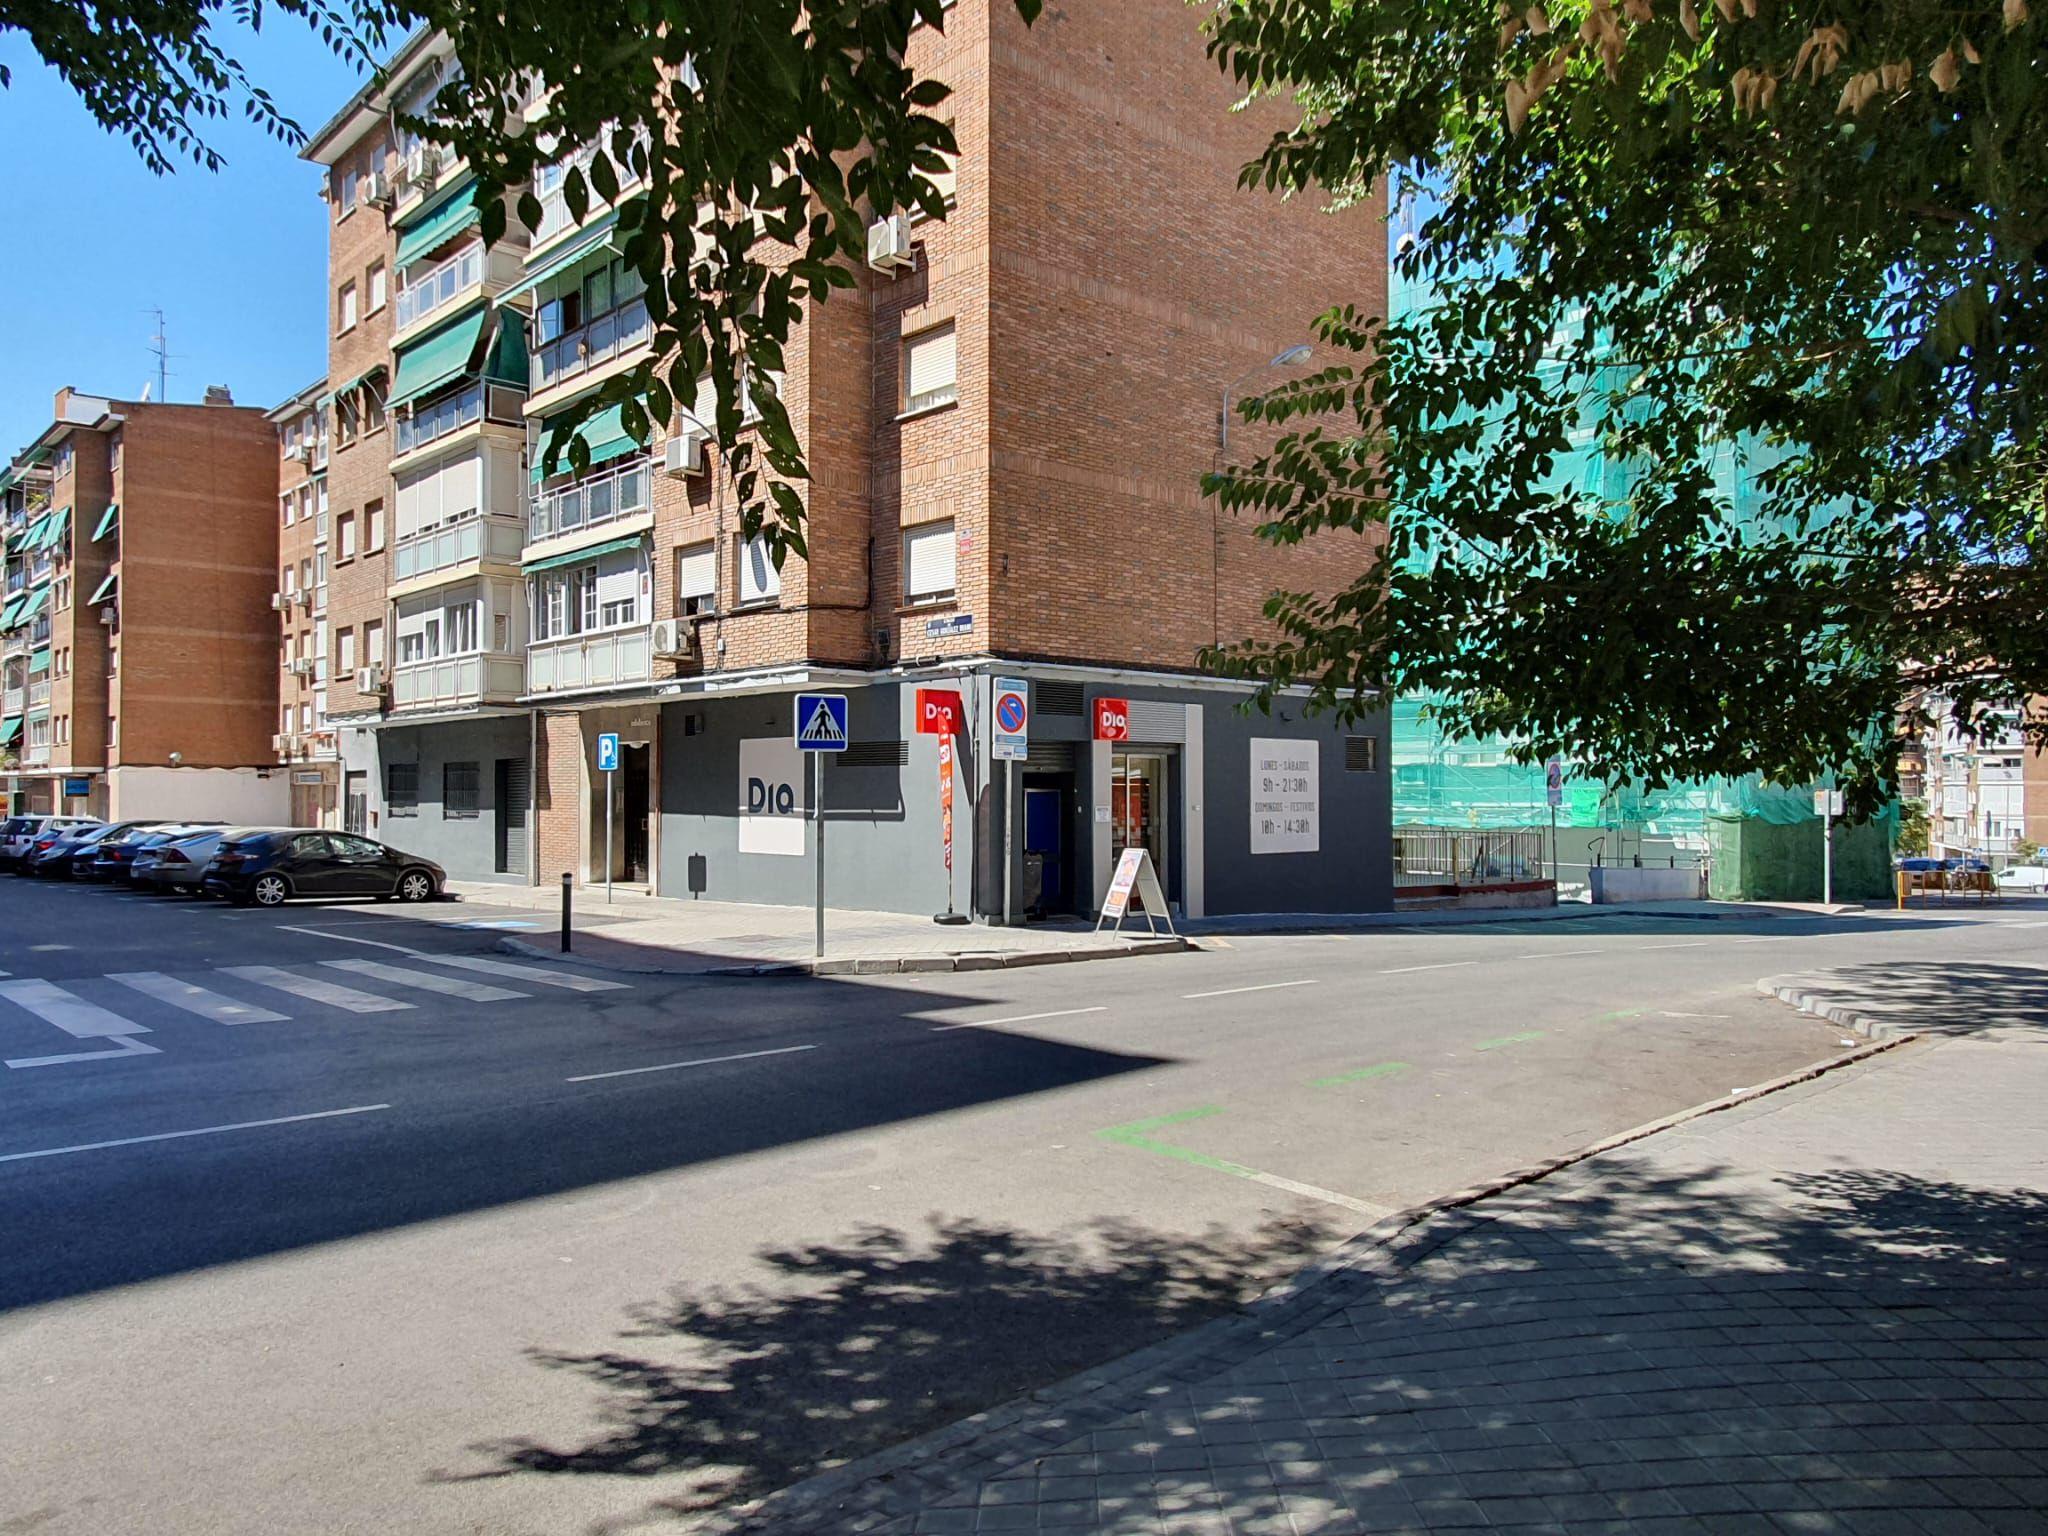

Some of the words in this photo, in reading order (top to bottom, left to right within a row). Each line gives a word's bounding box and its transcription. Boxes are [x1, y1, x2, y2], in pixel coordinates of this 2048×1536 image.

[926, 703, 953, 720] Da
[1102, 711, 1126, 727] Dia
[601, 738, 613, 767] P
[1263, 778, 1273, 793] 9h
[1283, 778, 1308, 793] 21:30h
[748, 777, 794, 815] Dia
[1261, 819, 1275, 835] 10h
[1284, 819, 1310, 834] 14:30h
